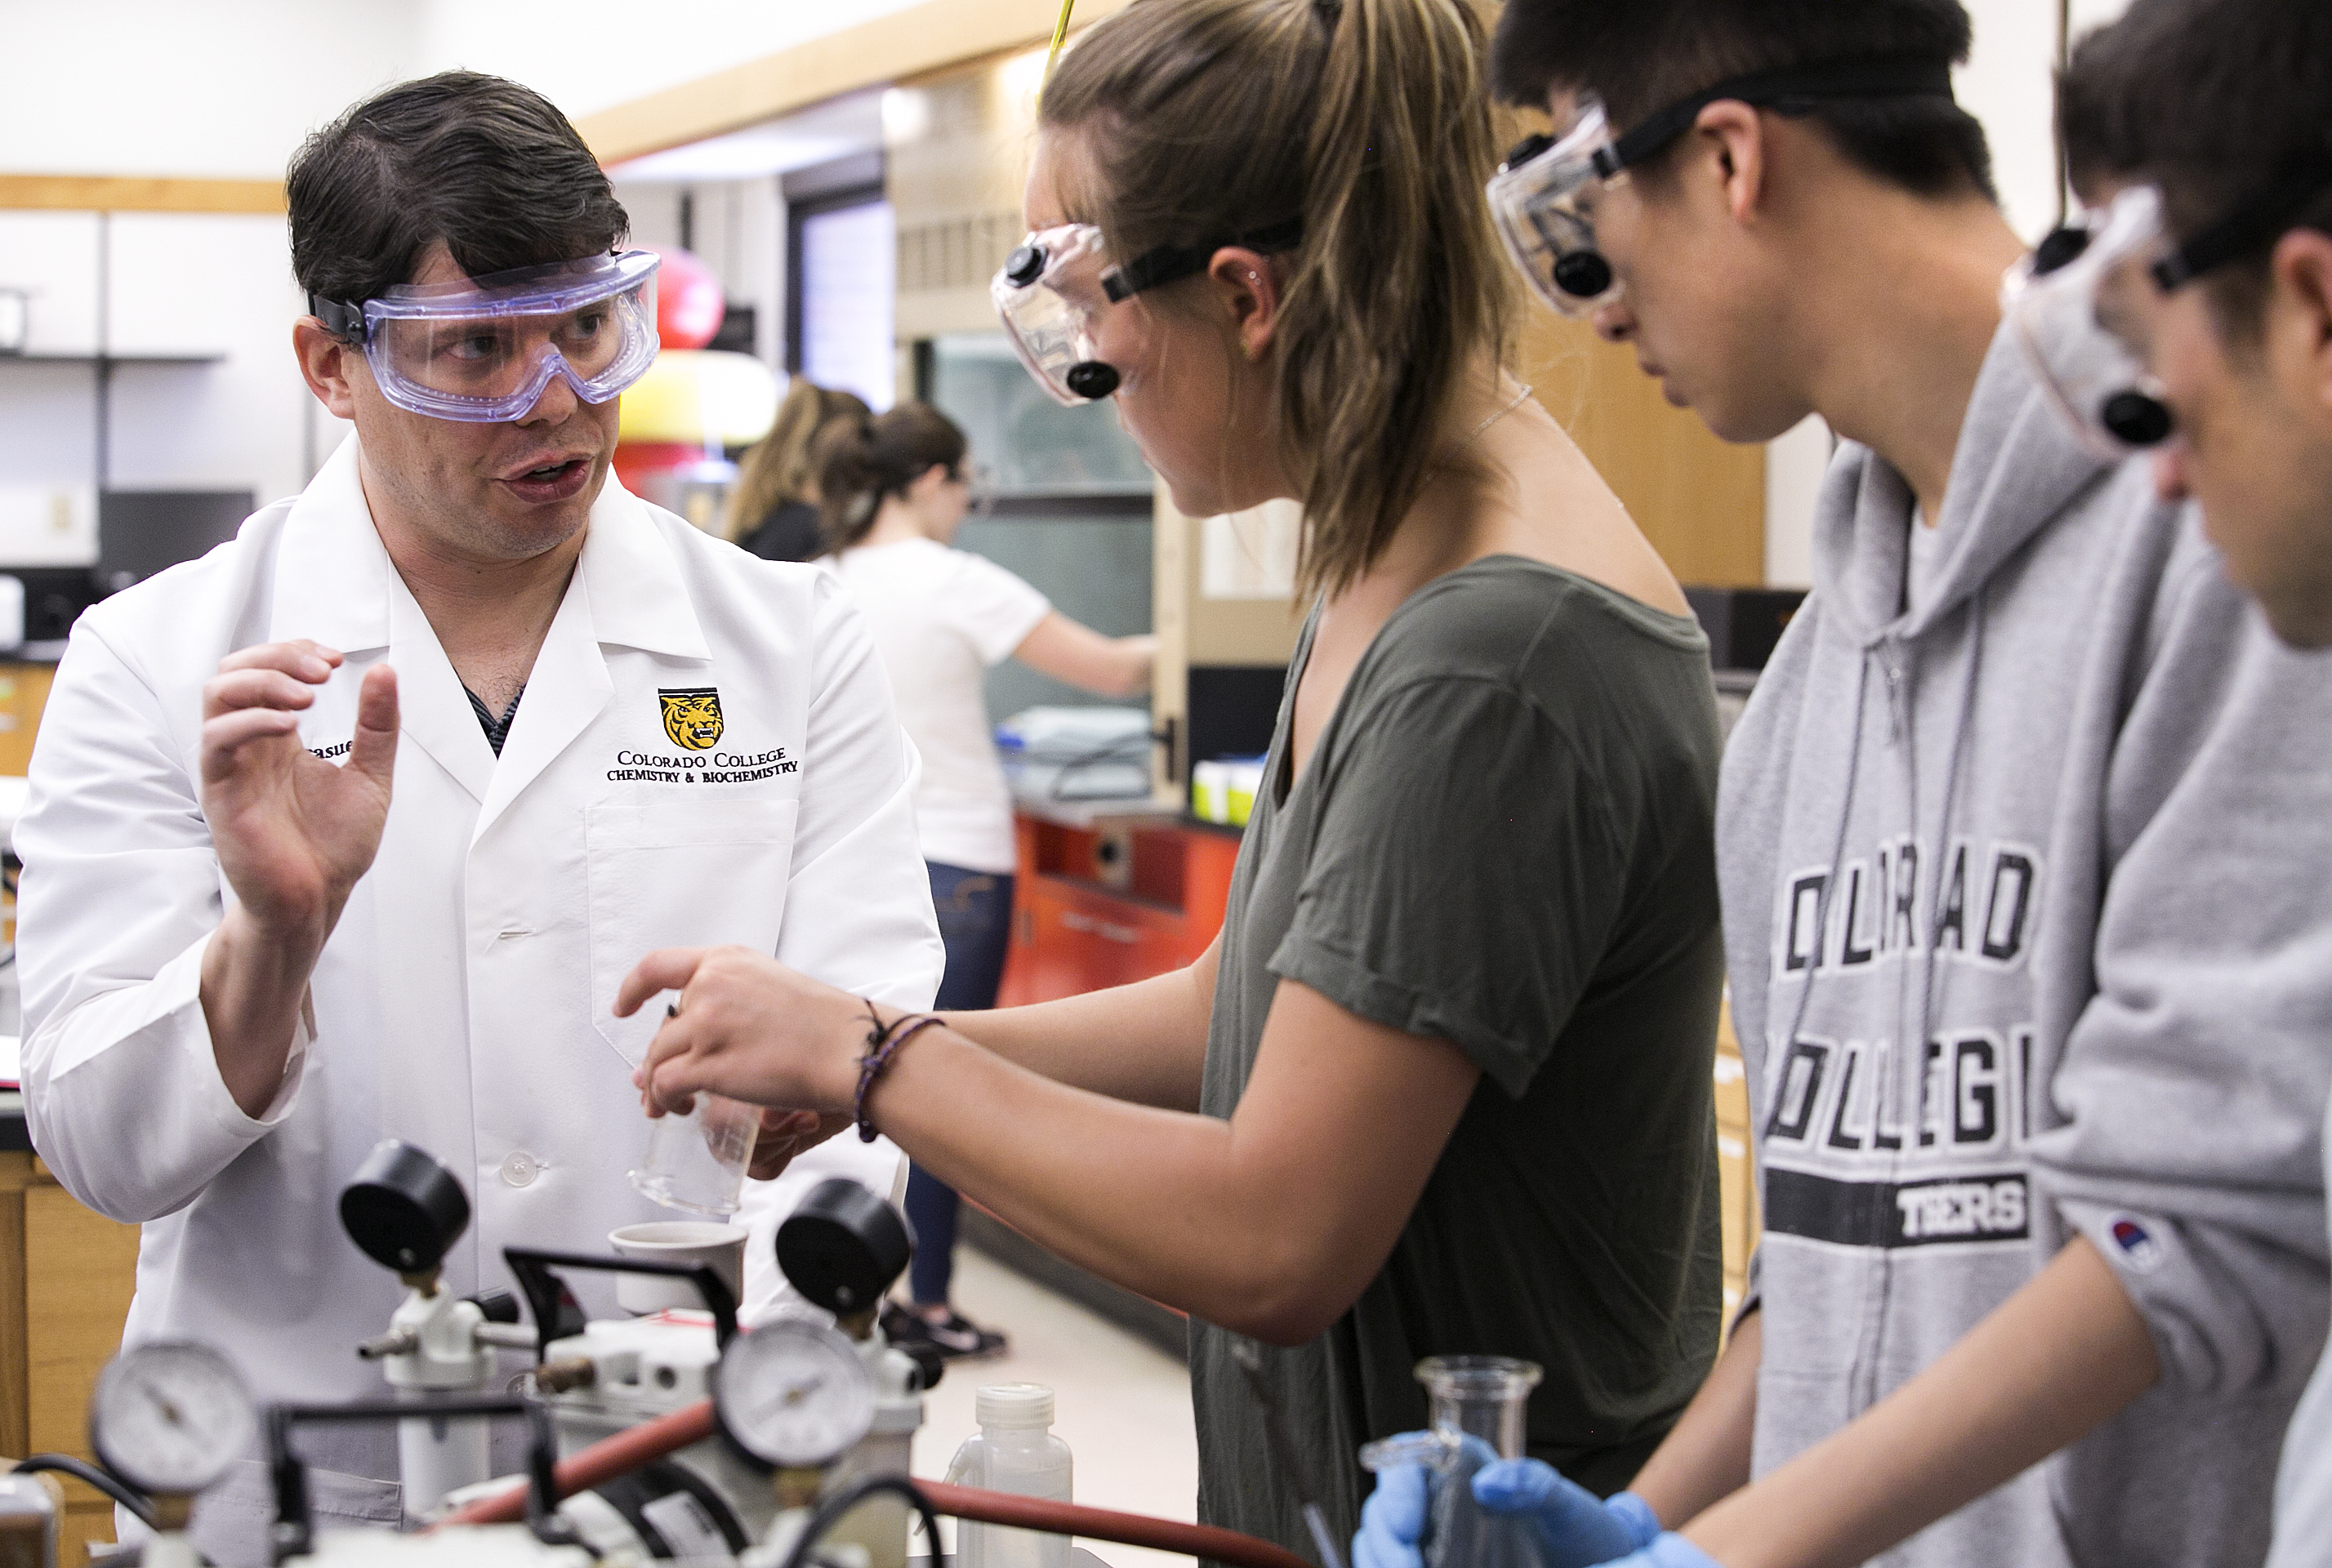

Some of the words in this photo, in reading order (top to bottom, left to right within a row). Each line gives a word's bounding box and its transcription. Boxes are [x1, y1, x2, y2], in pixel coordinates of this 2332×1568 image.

[307, 740, 353, 758] asue
[607, 769, 680, 782] CHEMISTRY
[685, 773, 694, 782] &
[702, 760, 798, 782] BIOCHEMISTRY
